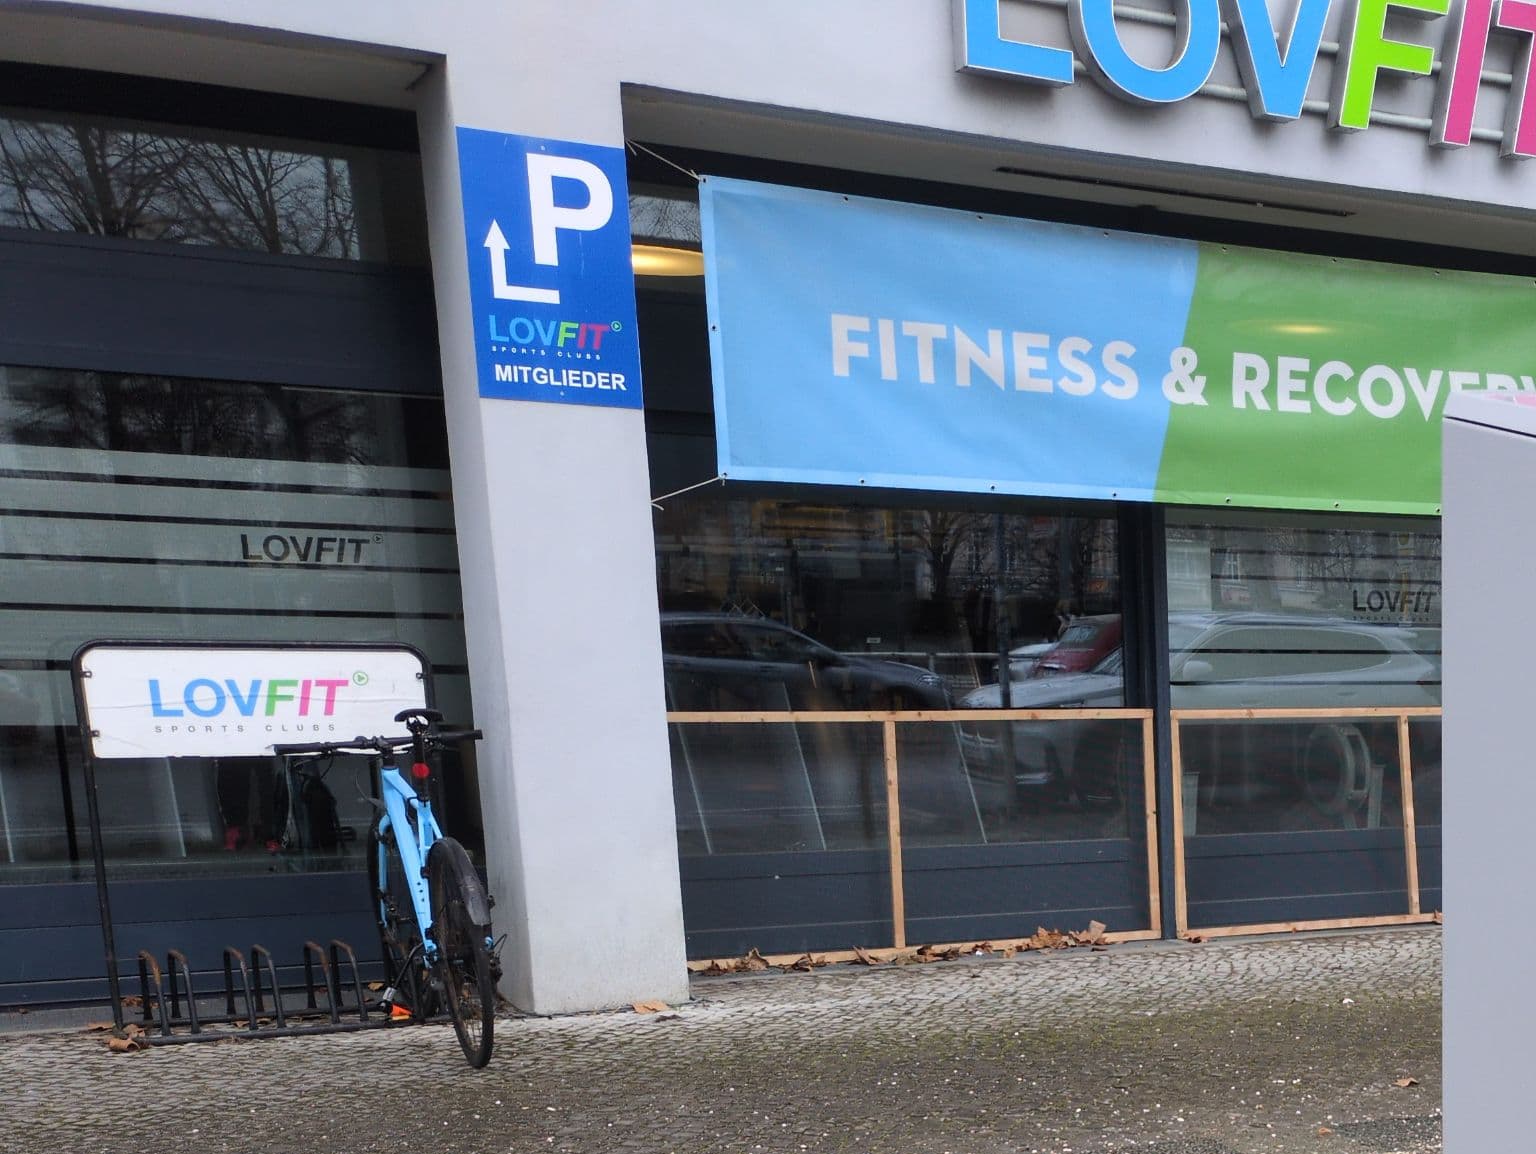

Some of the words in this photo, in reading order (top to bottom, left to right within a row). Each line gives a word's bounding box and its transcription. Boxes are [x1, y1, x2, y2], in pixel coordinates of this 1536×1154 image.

[526, 152, 614, 267] P
[488, 314, 610, 351] LOVFIT
[491, 345, 546, 356] SPORTS
[831, 313, 1140, 401] FITNESS
[1161, 346, 1209, 407] &
[494, 363, 628, 392] MITGLIEDER
[240, 533, 370, 564] LOVFIT
[1352, 589, 1437, 613] LOVFIT
[148, 678, 349, 718] LOVFIT
[155, 725, 244, 734] SPORTS
[265, 724, 336, 732] CLUBS
